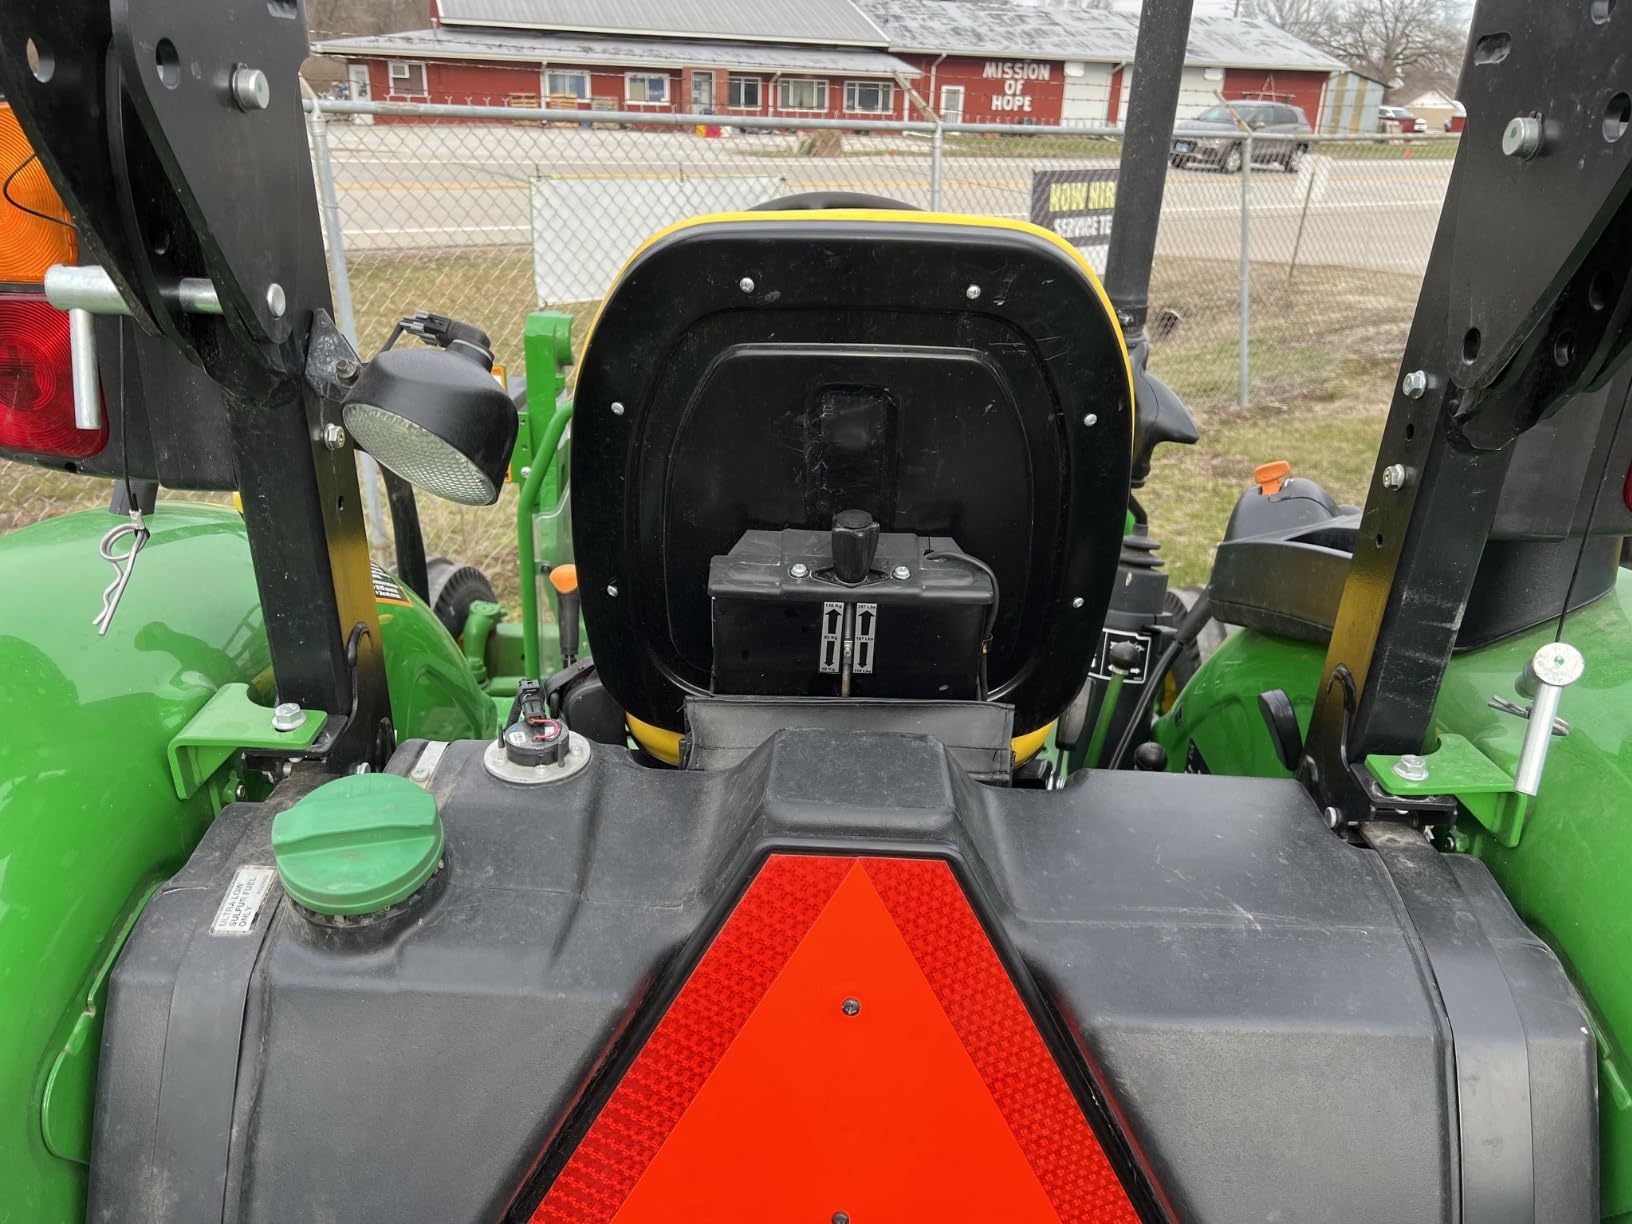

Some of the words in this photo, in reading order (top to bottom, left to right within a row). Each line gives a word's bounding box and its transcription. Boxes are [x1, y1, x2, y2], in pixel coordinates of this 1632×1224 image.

[983, 61, 1051, 80] MISSION
[1004, 79, 1025, 95] OF
[991, 95, 1033, 111] HOPE
[1049, 182, 1088, 212] NOW
[1054, 215, 1098, 238] SERVICE
[219, 901, 235, 926] ULTRA
[233, 883, 244, 900] LOW
[230, 896, 247, 926] SULFUR
[243, 877, 256, 895] FUEL
[239, 906, 252, 926] ONLY
